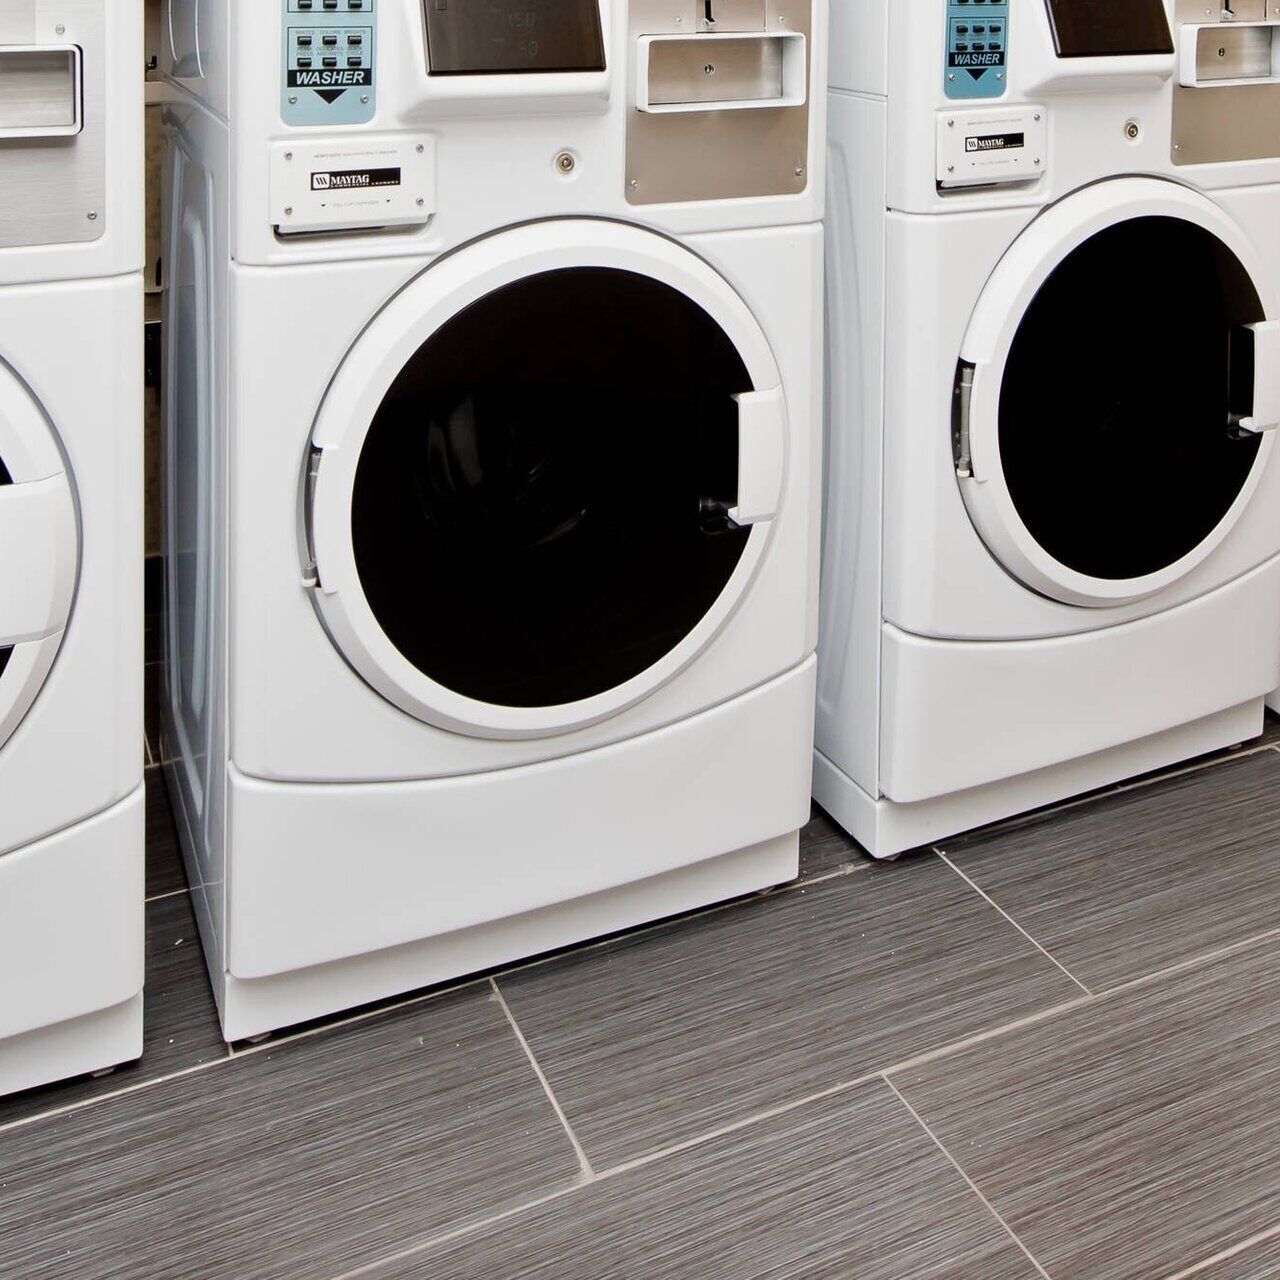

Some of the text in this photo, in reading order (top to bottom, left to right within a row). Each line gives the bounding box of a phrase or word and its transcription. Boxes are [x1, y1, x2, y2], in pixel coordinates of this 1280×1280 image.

[954, 53, 1000, 65] WASHER
[296, 71, 365, 85] WASHER
[977, 138, 1004, 147] MAYTAG
[330, 174, 370, 185] MAYTAG
